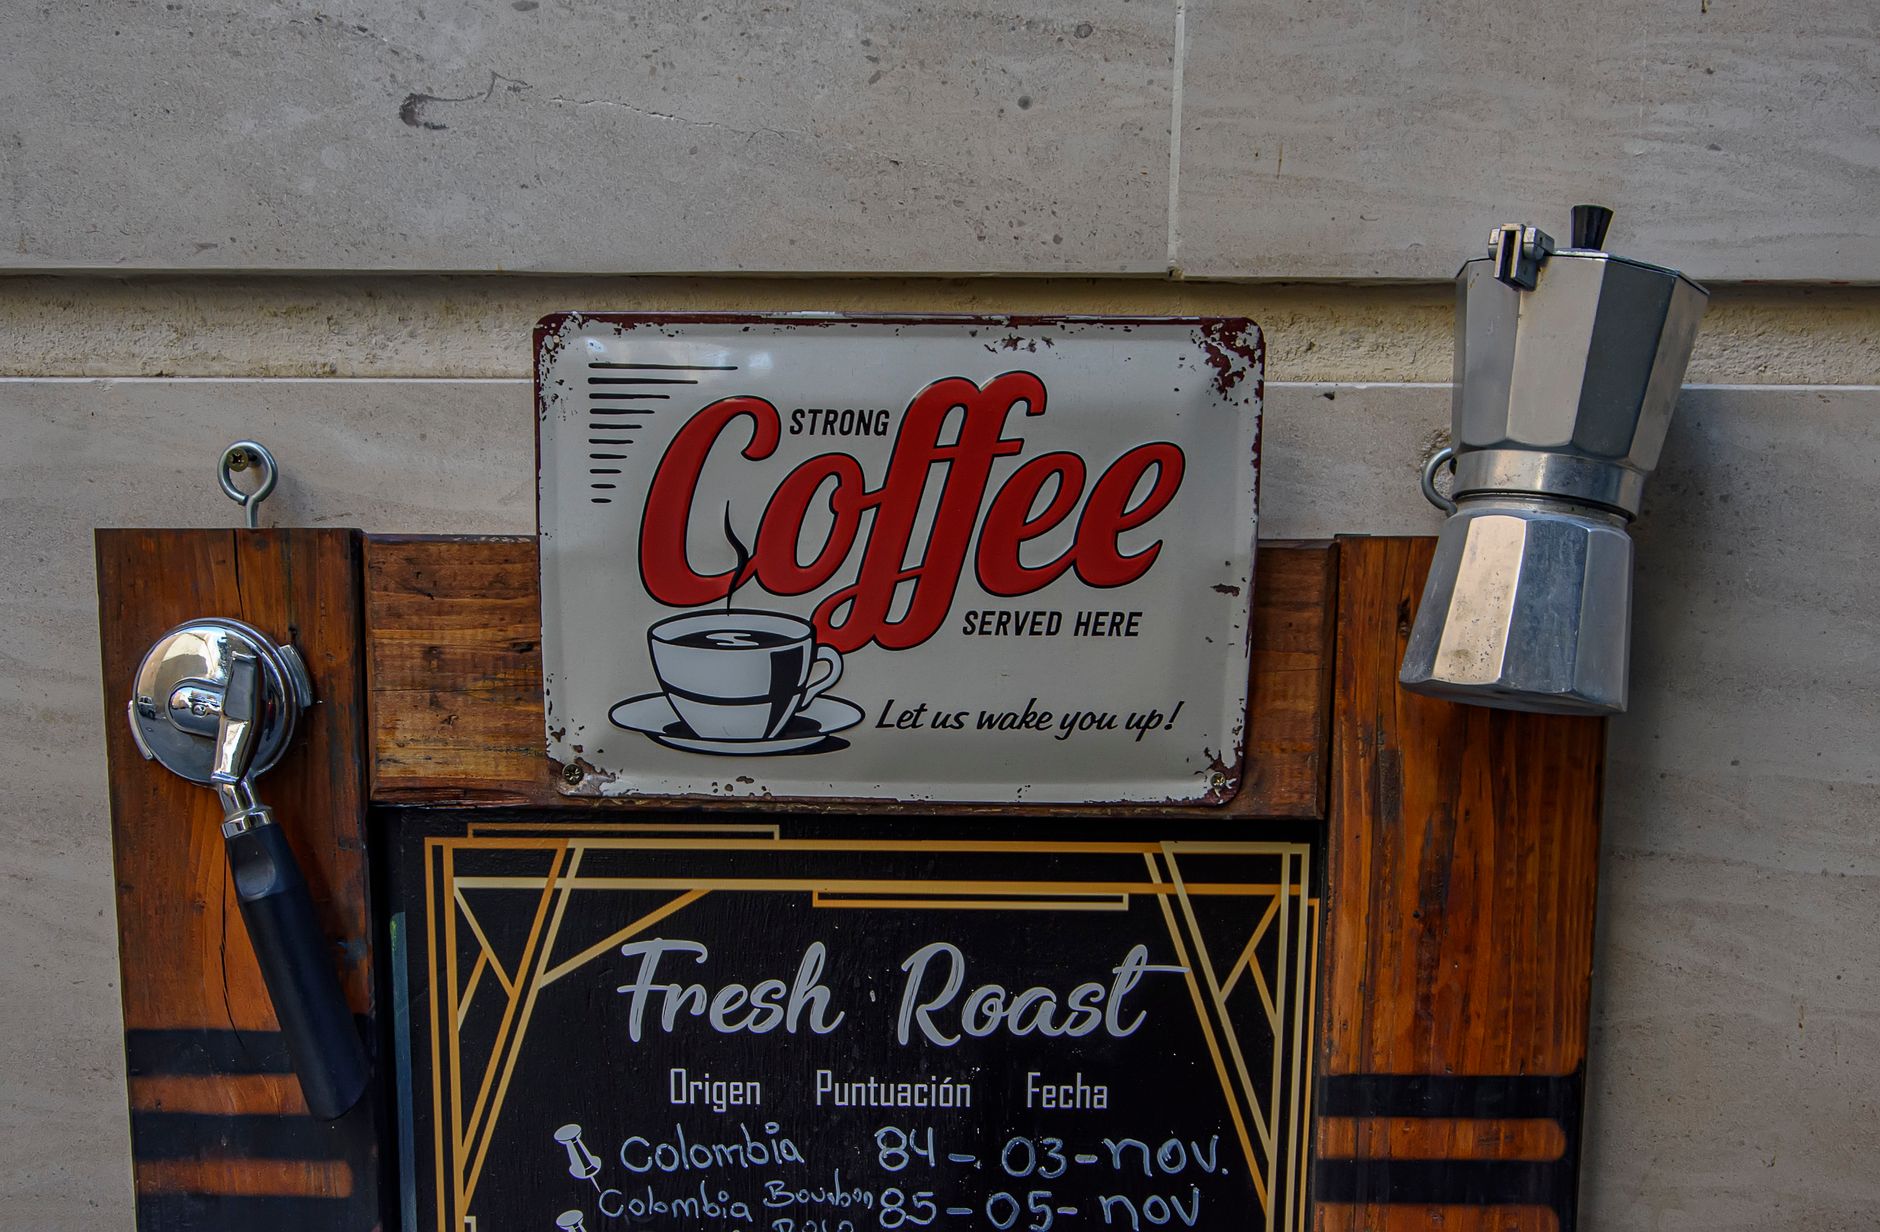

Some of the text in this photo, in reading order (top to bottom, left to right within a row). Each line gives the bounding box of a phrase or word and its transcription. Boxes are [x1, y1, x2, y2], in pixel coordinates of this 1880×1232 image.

[790, 409, 890, 436] STRONG
[638, 370, 1186, 652] Coffee
[963, 610, 1143, 638] SERVED HERE
[875, 697, 1185, 742] Let us wake you up!
[617, 938, 1190, 1046] Fresh Roast
[670, 1068, 1108, 1112] Origen Puntuación Fecha
[620, 1122, 805, 1172] Colombia
[599, 1179, 753, 1222] Colombia
